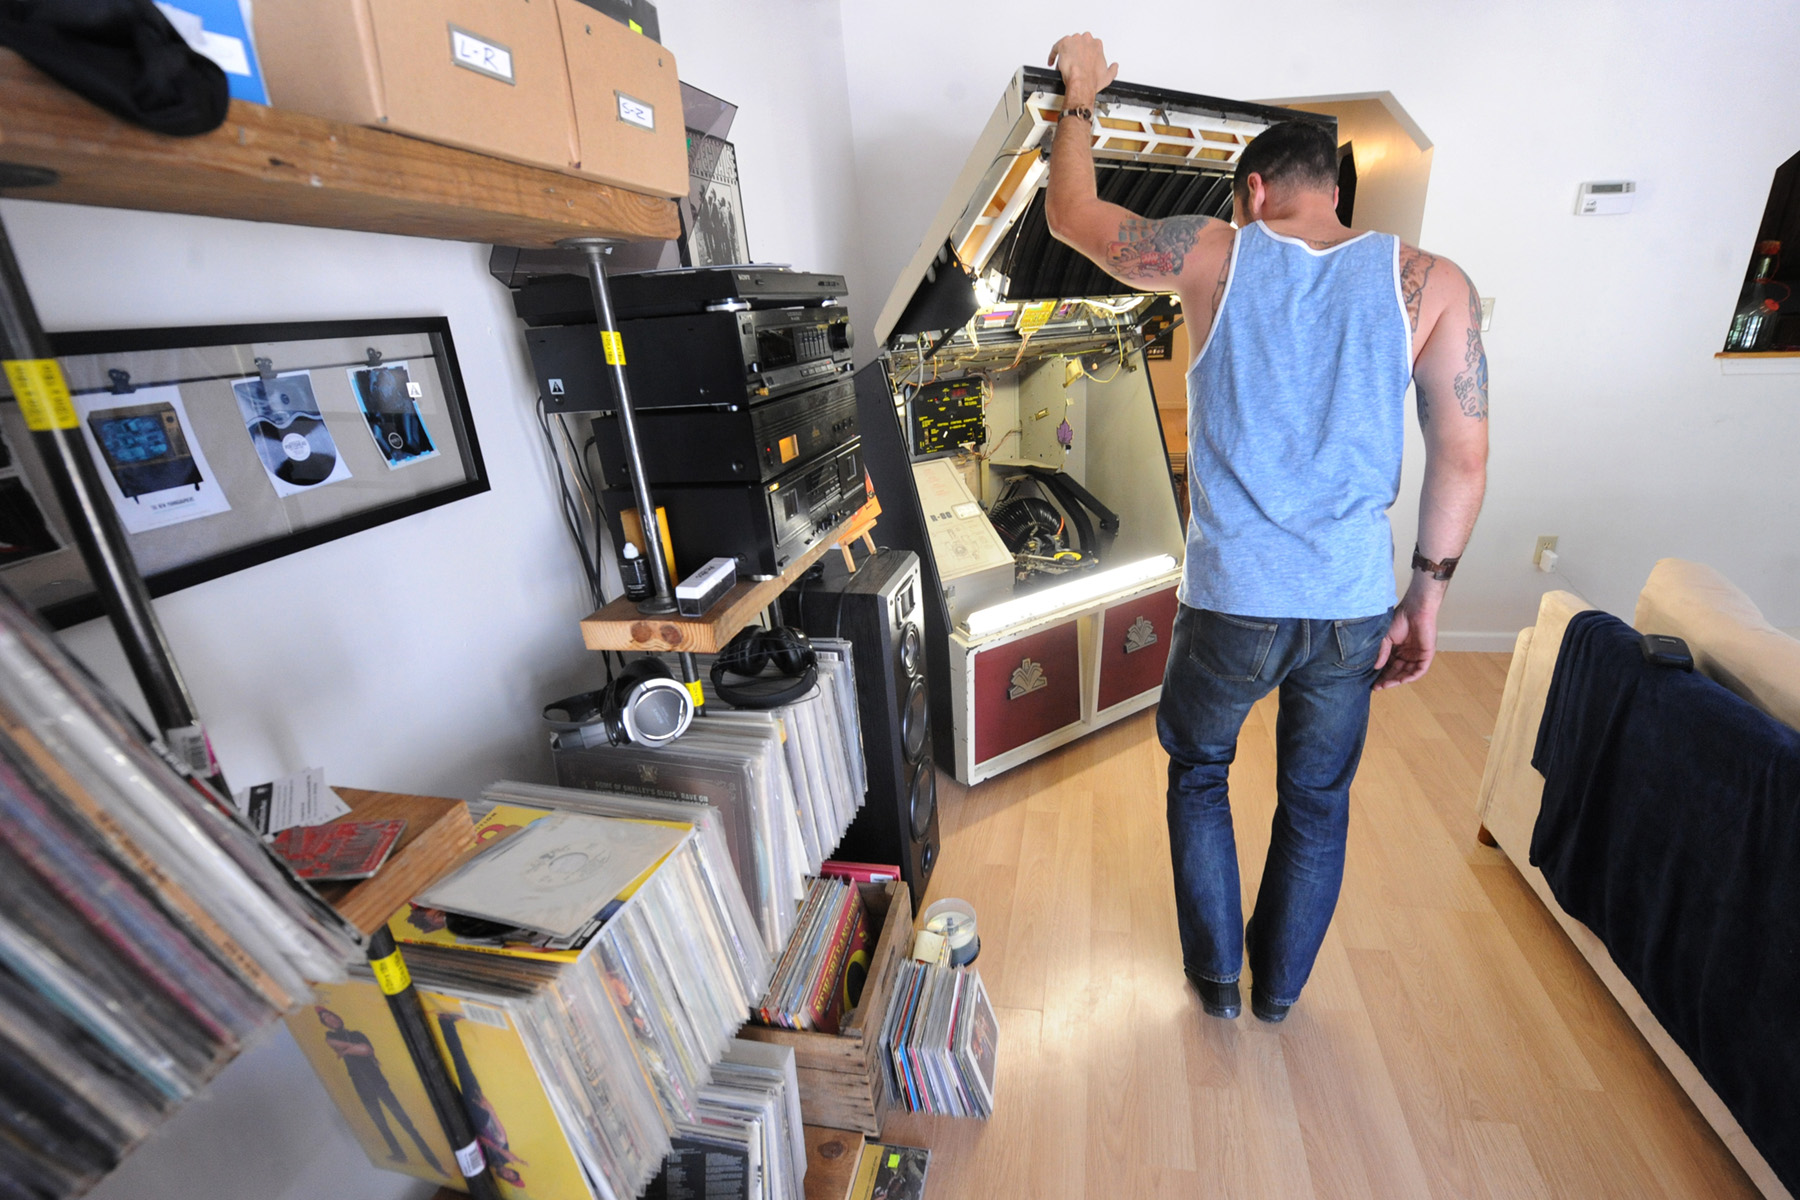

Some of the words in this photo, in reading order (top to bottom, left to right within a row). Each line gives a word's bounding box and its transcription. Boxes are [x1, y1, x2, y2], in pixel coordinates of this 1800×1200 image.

[461, 40, 498, 71] L-R
[622, 102, 646, 120] S-Z
[828, 921, 850, 980] ORLEANS
